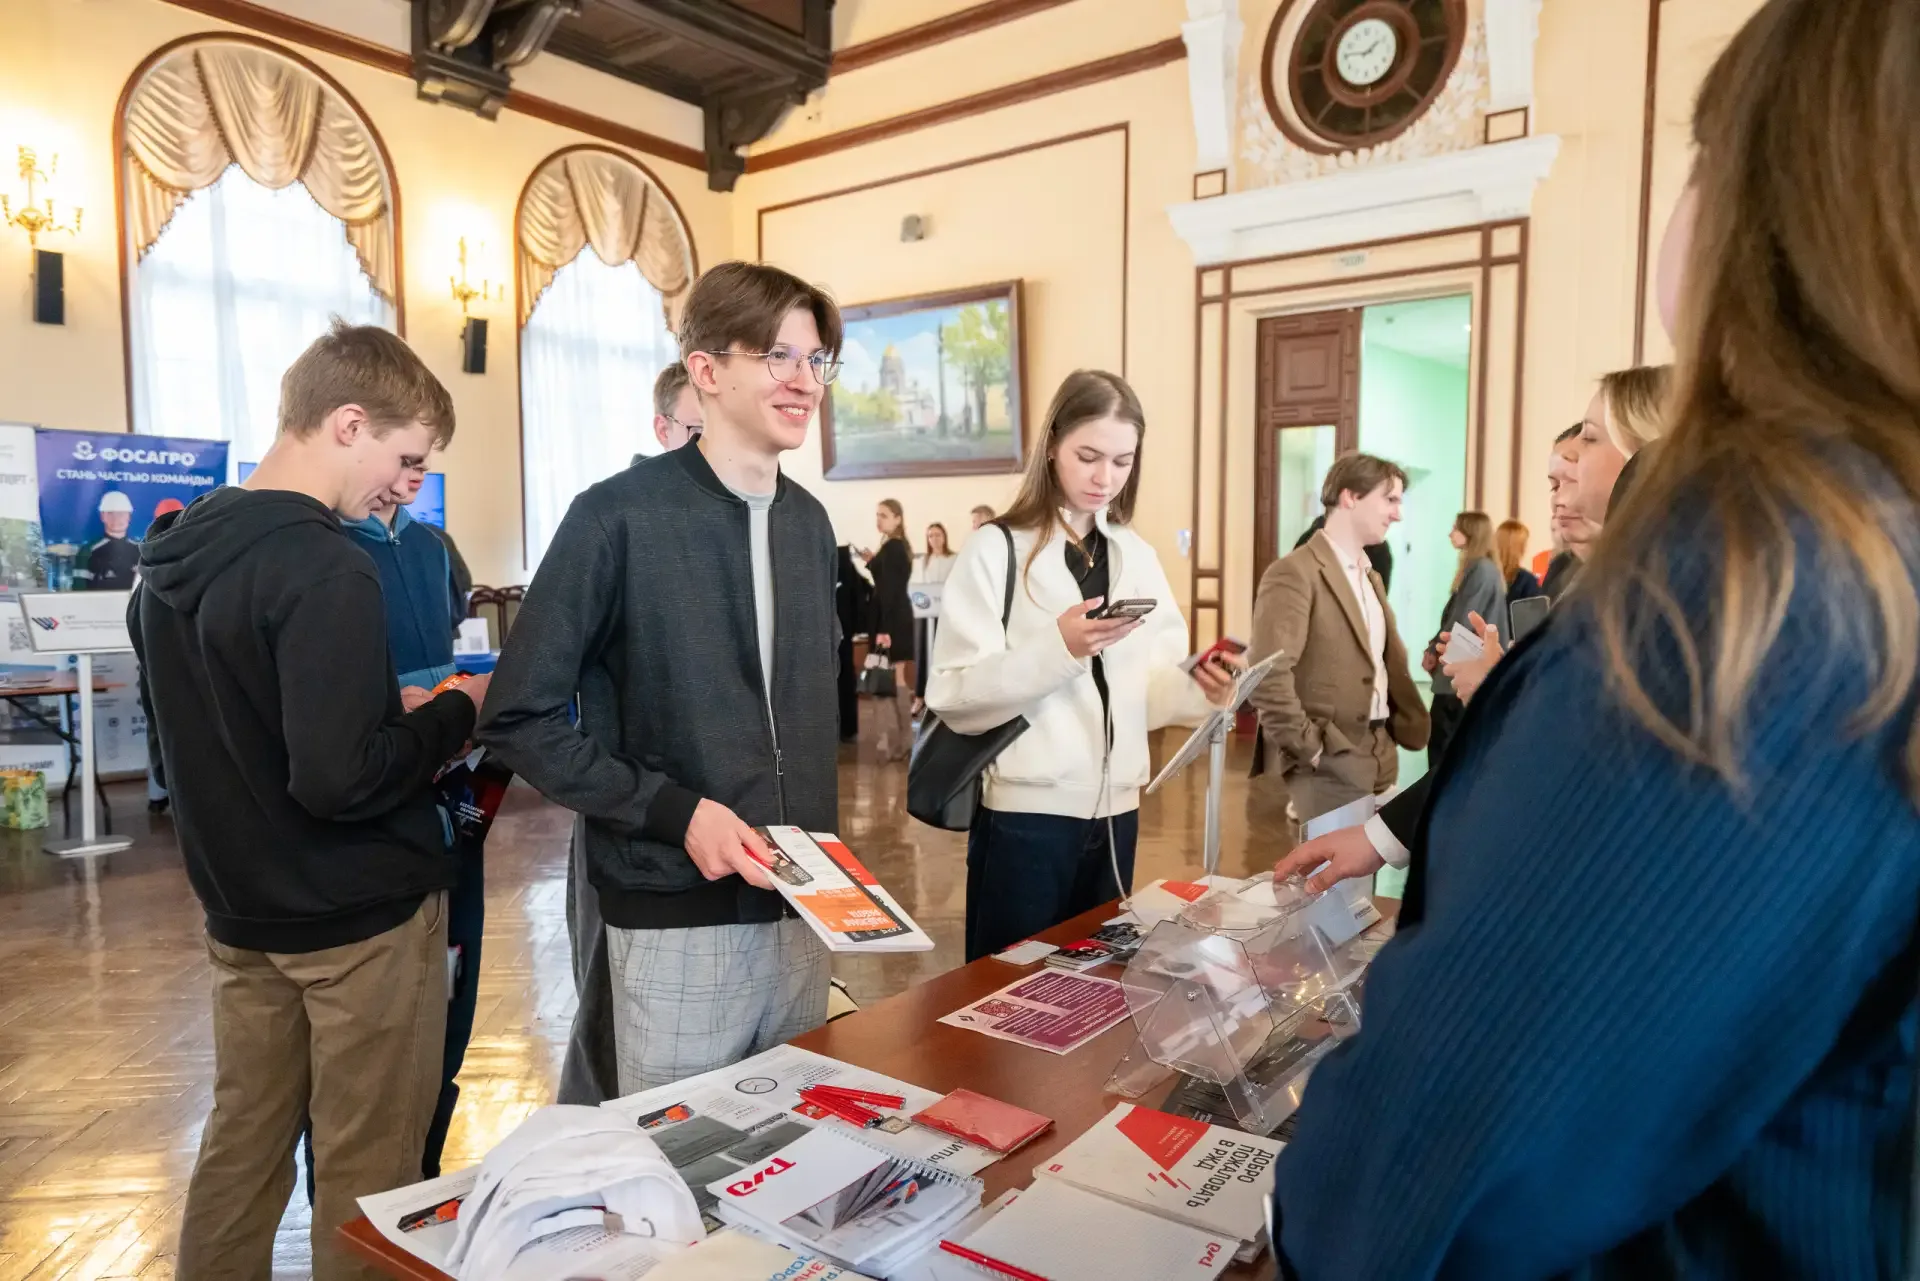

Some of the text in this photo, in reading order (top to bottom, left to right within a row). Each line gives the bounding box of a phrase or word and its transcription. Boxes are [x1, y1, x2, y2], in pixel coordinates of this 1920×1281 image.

[101, 447, 196, 467] ФОСАГРО
[56, 468, 214, 487] СТАНЬ ЧАСТЬЮ КОМАНДЫ!
[1193, 1139, 1236, 1171] В РЖД
[1237, 1148, 1275, 1184] ДОБРО
[1186, 1144, 1256, 1208] ПОЖАЛОВАТЬ
